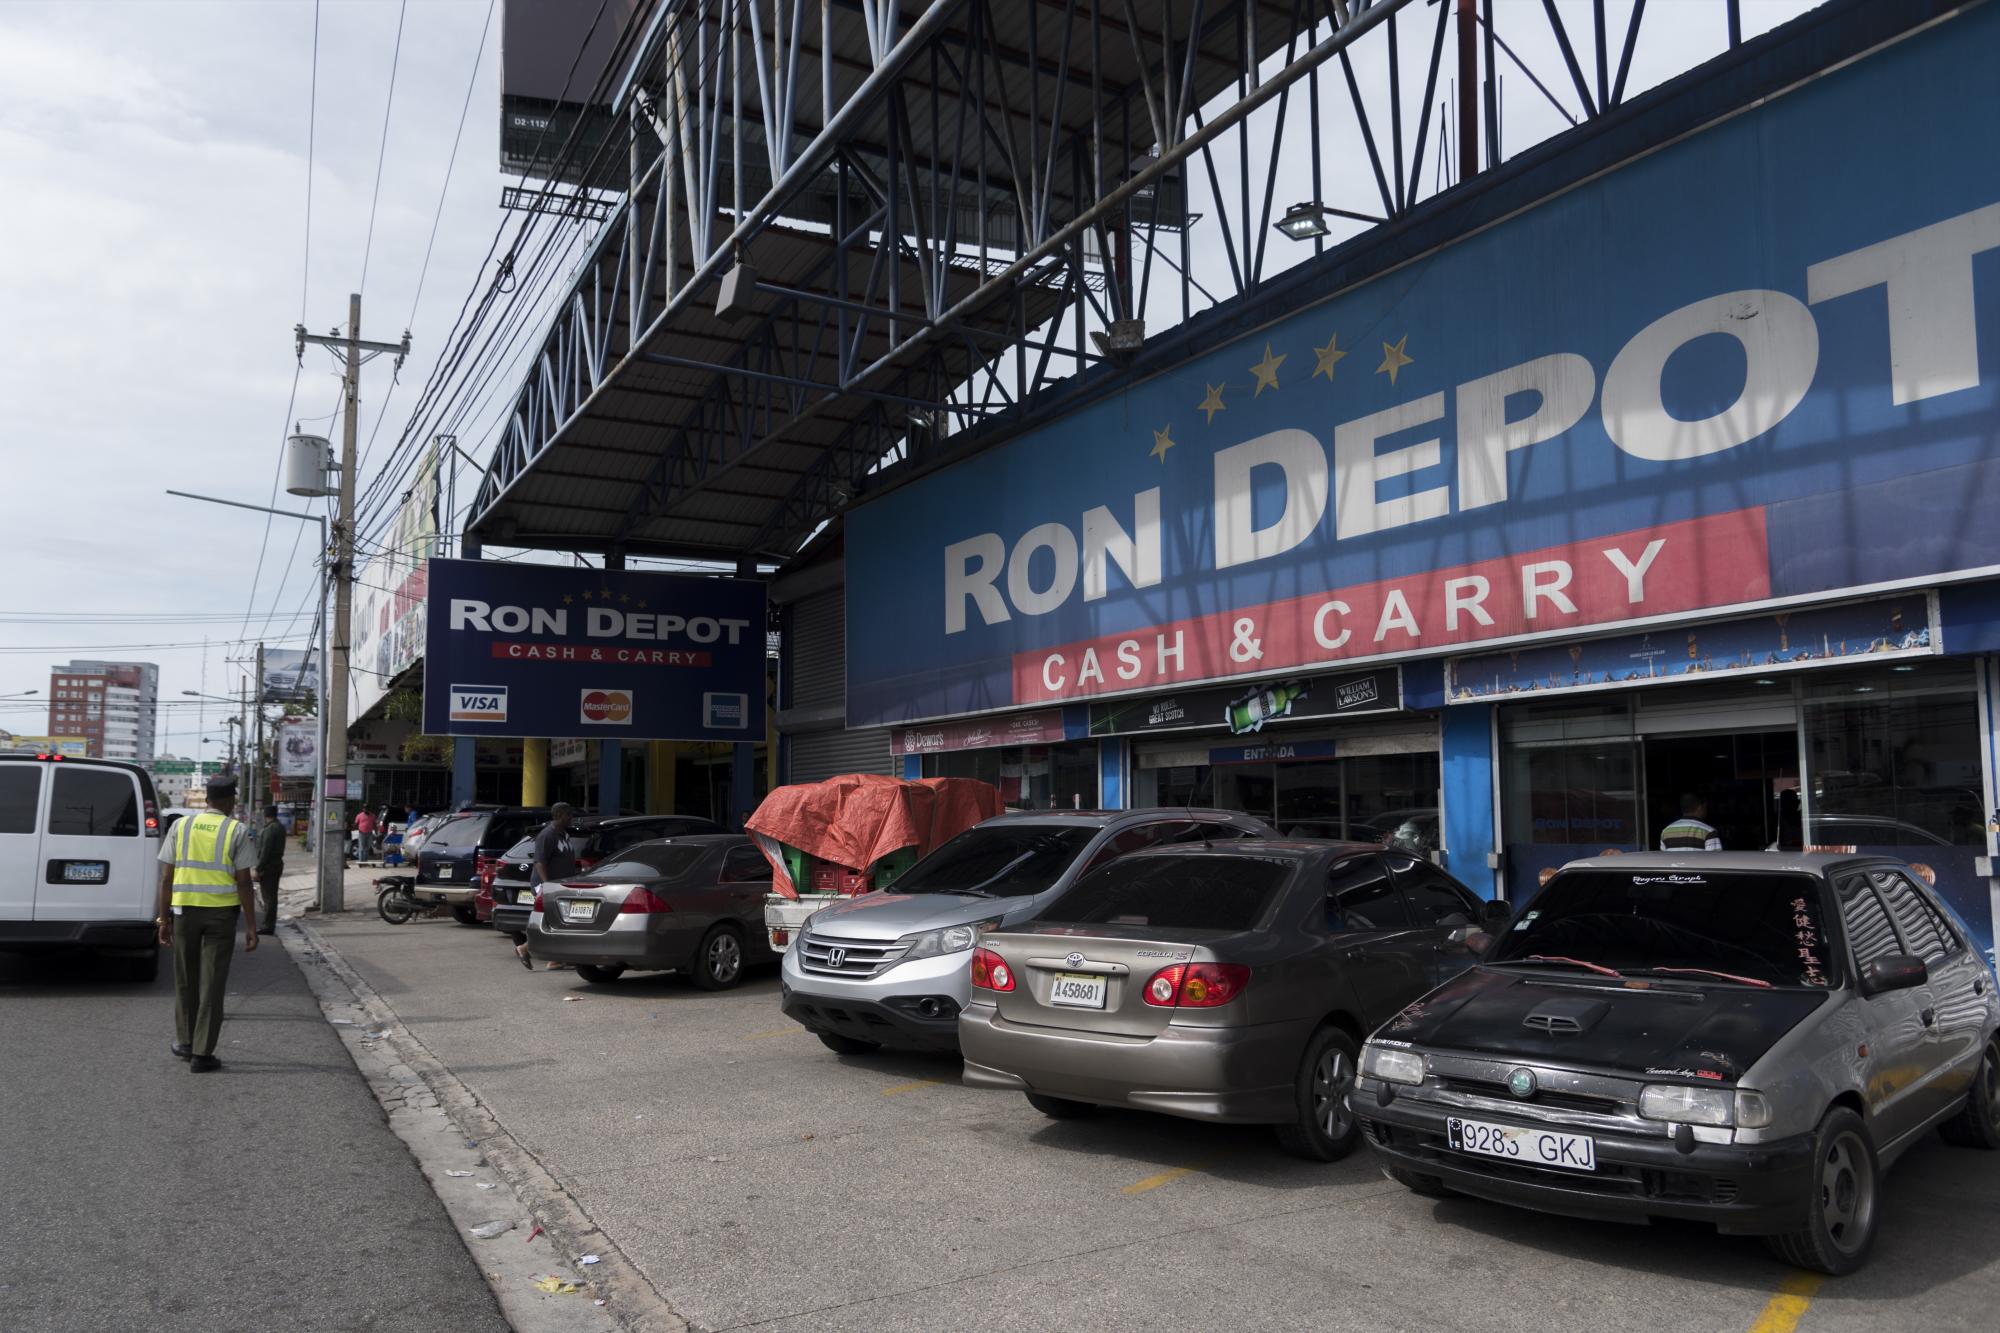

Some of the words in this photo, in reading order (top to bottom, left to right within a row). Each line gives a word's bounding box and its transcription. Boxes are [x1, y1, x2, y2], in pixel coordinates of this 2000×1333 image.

[943, 486, 1163, 636] RON
[1213, 204, 2000, 569] DEPOT
[449, 598, 567, 637] RON
[587, 607, 750, 645] DEPOT
[1042, 630, 1186, 692] CASH
[1227, 617, 1264, 662] &
[1313, 538, 1668, 650] CARRY
[508, 644, 576, 660] CASH
[590, 647, 603, 661] &
[618, 649, 698, 665] CARRY
[1338, 680, 1371, 696] WILLIAM
[460, 696, 499, 711] VISA
[583, 700, 631, 713] MasterCard
[1148, 712, 1164, 724] GREAT
[1165, 708, 1185, 721] SCOTCH
[916, 730, 944, 748] Dewar's
[193, 823, 218, 832] AMET
[1054, 981, 1099, 1000] A458681
[1539, 1134, 1592, 1167] GKJ
